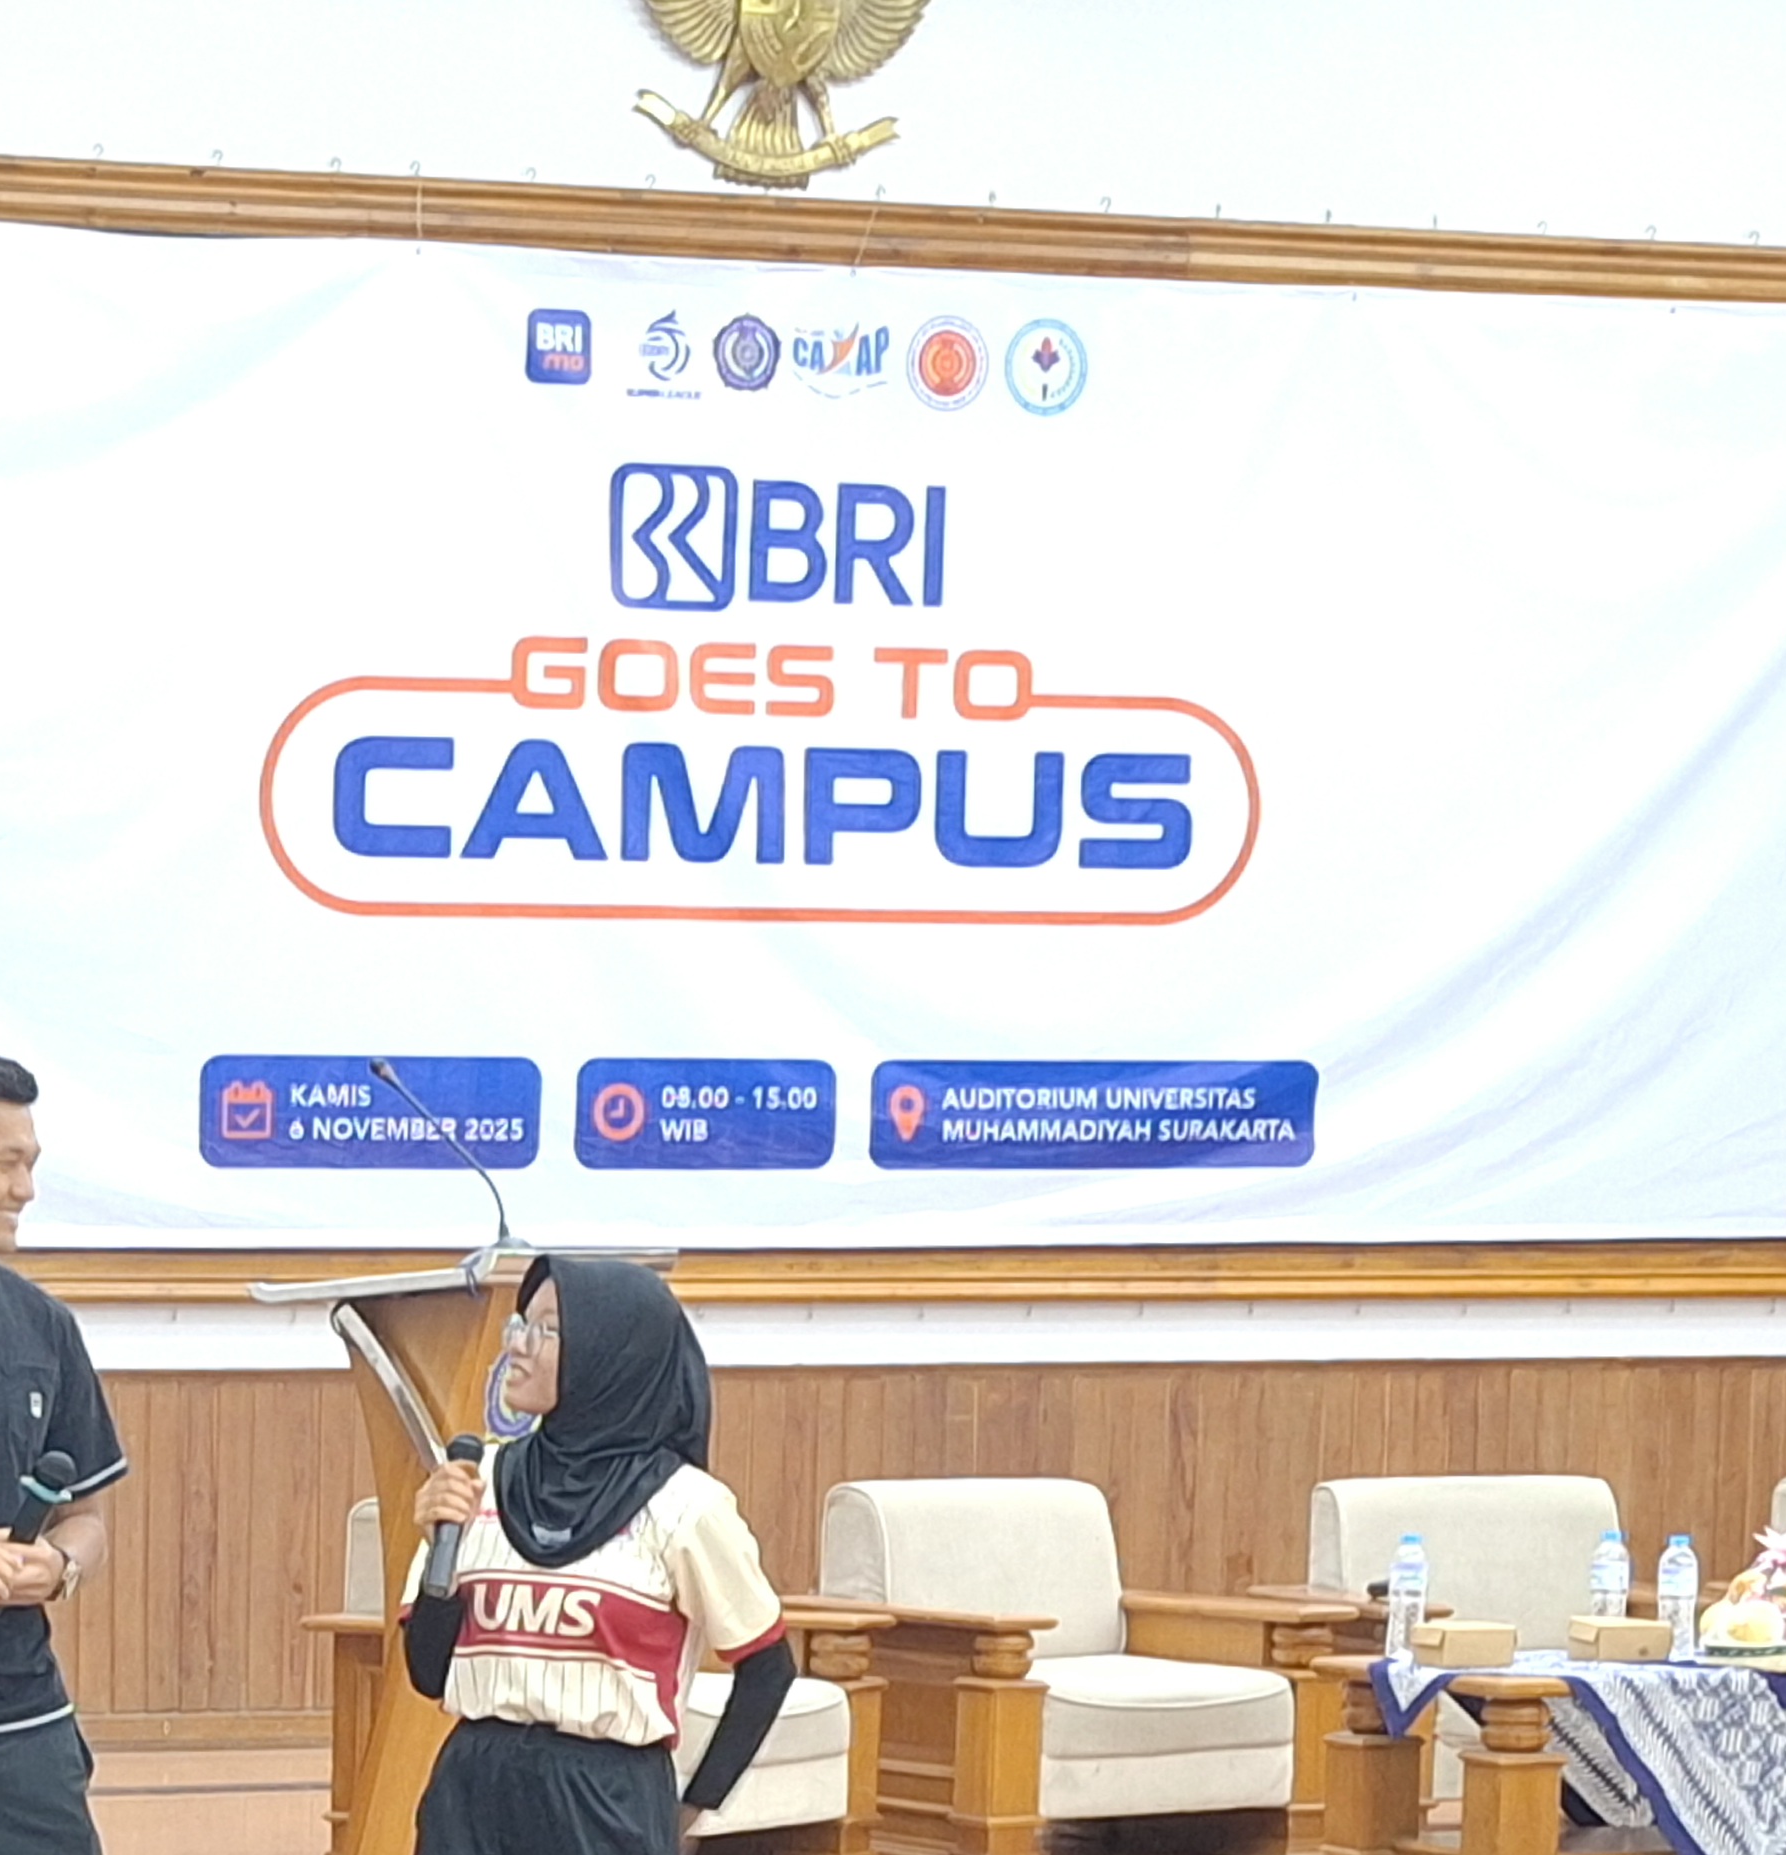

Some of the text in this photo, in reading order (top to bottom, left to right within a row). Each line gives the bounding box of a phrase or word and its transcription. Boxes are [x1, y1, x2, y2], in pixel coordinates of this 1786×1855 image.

[535, 321, 582, 354] BRI
[542, 352, 585, 373] mo
[793, 325, 890, 377] CAAP
[748, 478, 948, 607] BRI
[511, 635, 1033, 721] GOES TO
[332, 734, 1193, 870] CAMPUS
[290, 1083, 372, 1107] KAMIS
[661, 1085, 730, 1110] 08.00
[752, 1086, 818, 1111] 15.00
[942, 1086, 1256, 1111] AUDITORIUM UNIVERSITAS
[288, 1116, 525, 1142] 6 NOVEMBER 2025
[660, 1118, 709, 1143] WIB
[942, 1118, 1297, 1143] MUHAMMADIYAH SURAKARTA
[473, 1582, 601, 1638] UMS
